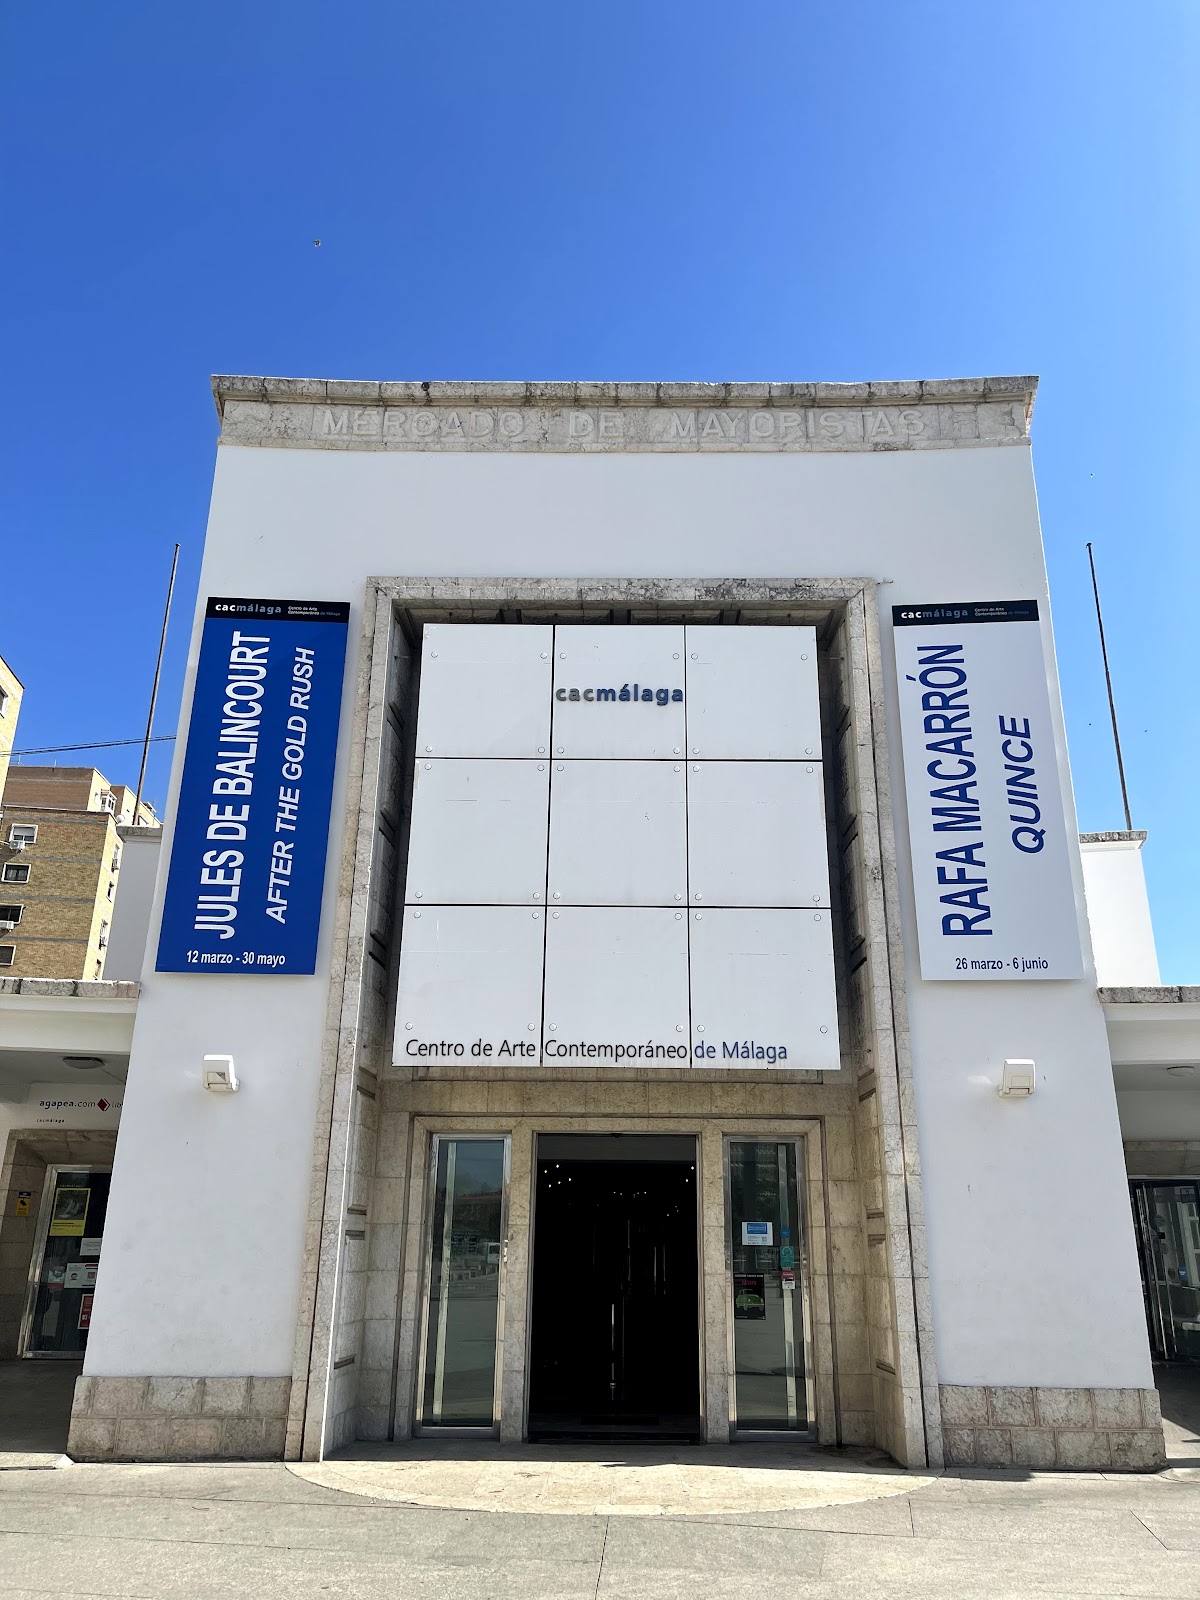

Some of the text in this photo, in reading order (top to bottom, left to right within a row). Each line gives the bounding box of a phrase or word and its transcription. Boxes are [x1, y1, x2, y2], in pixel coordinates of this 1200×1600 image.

[321, 409, 927, 439] MERCADO DE MAYORISTAS
[215, 603, 282, 615] cacmálaga
[900, 608, 969, 619] cacmálaga
[555, 683, 684, 707] cacmálaga
[194, 630, 270, 940] JULES DE BALINCOURT
[265, 646, 315, 925] AFTER THE GOLD RUSH
[906, 644, 993, 937] RAFA MACARRÓN
[998, 714, 1046, 854] QUINCE
[186, 950, 199, 964] 12
[201, 953, 233, 964] marzo
[242, 952, 255, 965] 30
[257, 954, 285, 967] mayo
[955, 957, 968, 970] 26
[971, 959, 1003, 970] marzo
[1012, 957, 1019, 969] 6
[1021, 956, 1049, 972] junio
[405, 1038, 788, 1064] Centro de Arte Contemporáneo de Málaga
[39, 1100, 96, 1109] agapea.com
